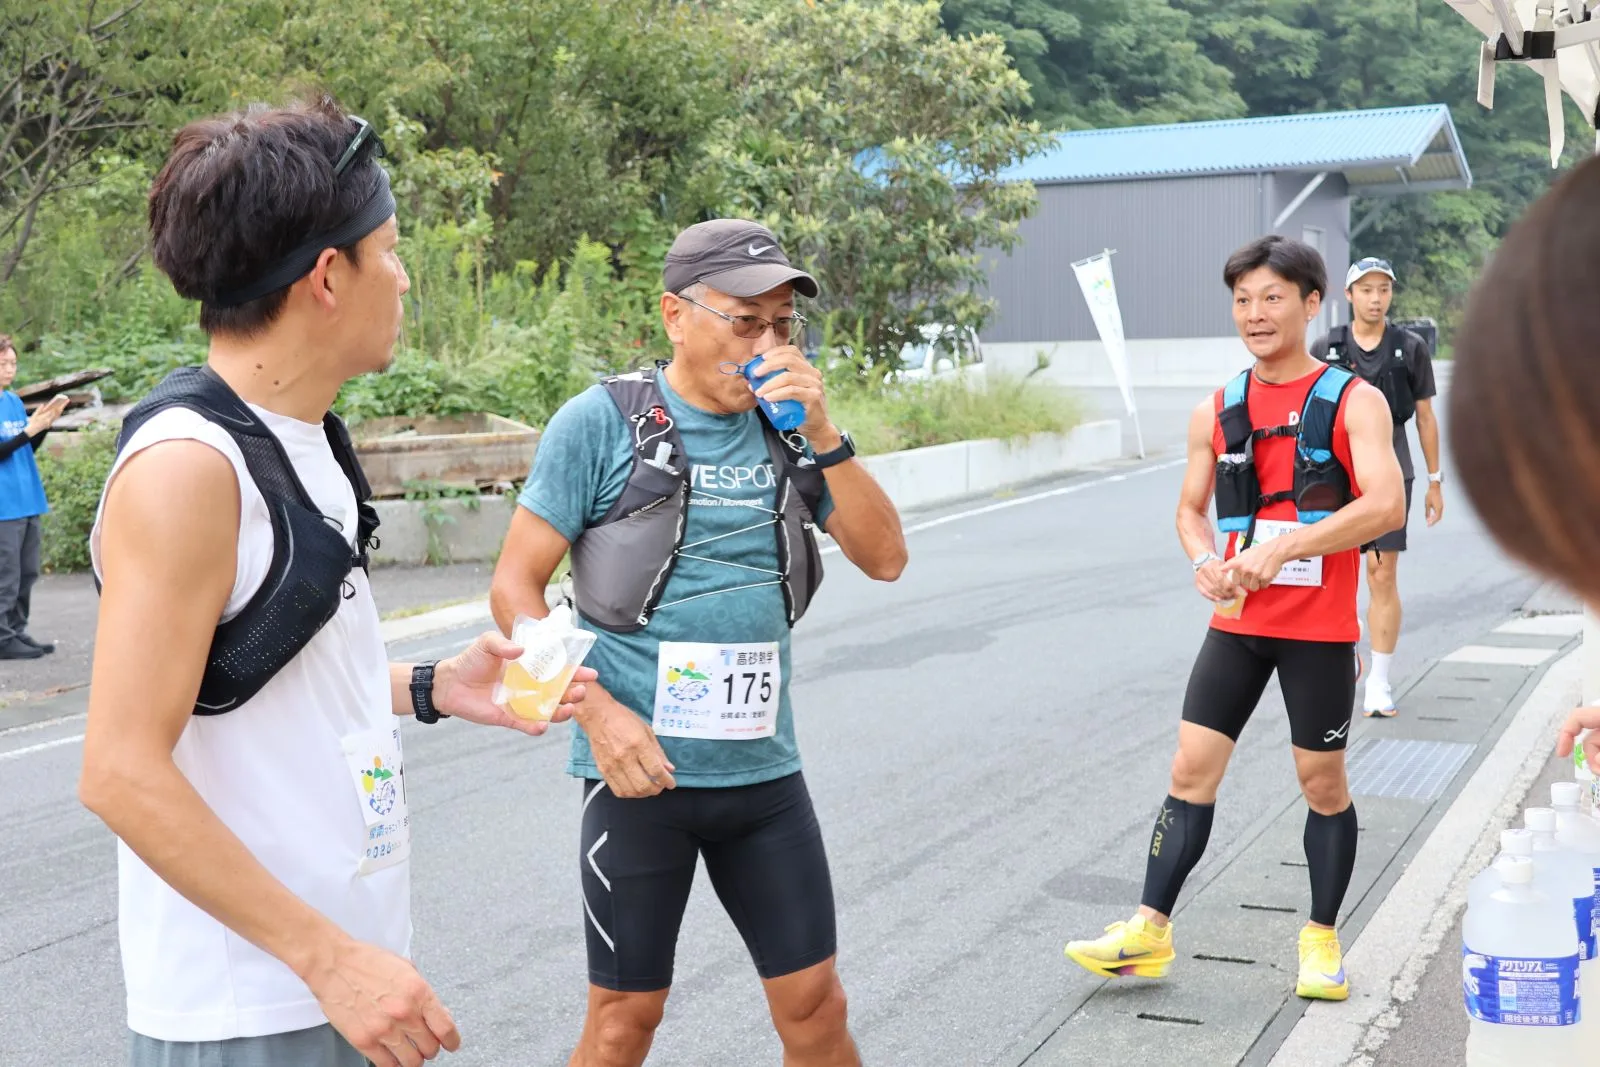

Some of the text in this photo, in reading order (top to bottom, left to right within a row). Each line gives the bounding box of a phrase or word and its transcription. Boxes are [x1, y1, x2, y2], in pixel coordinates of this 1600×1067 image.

[723, 672, 772, 704] 175
[1151, 831, 1163, 857] 2XU
[1498, 960, 1544, 972] アクエリアス
